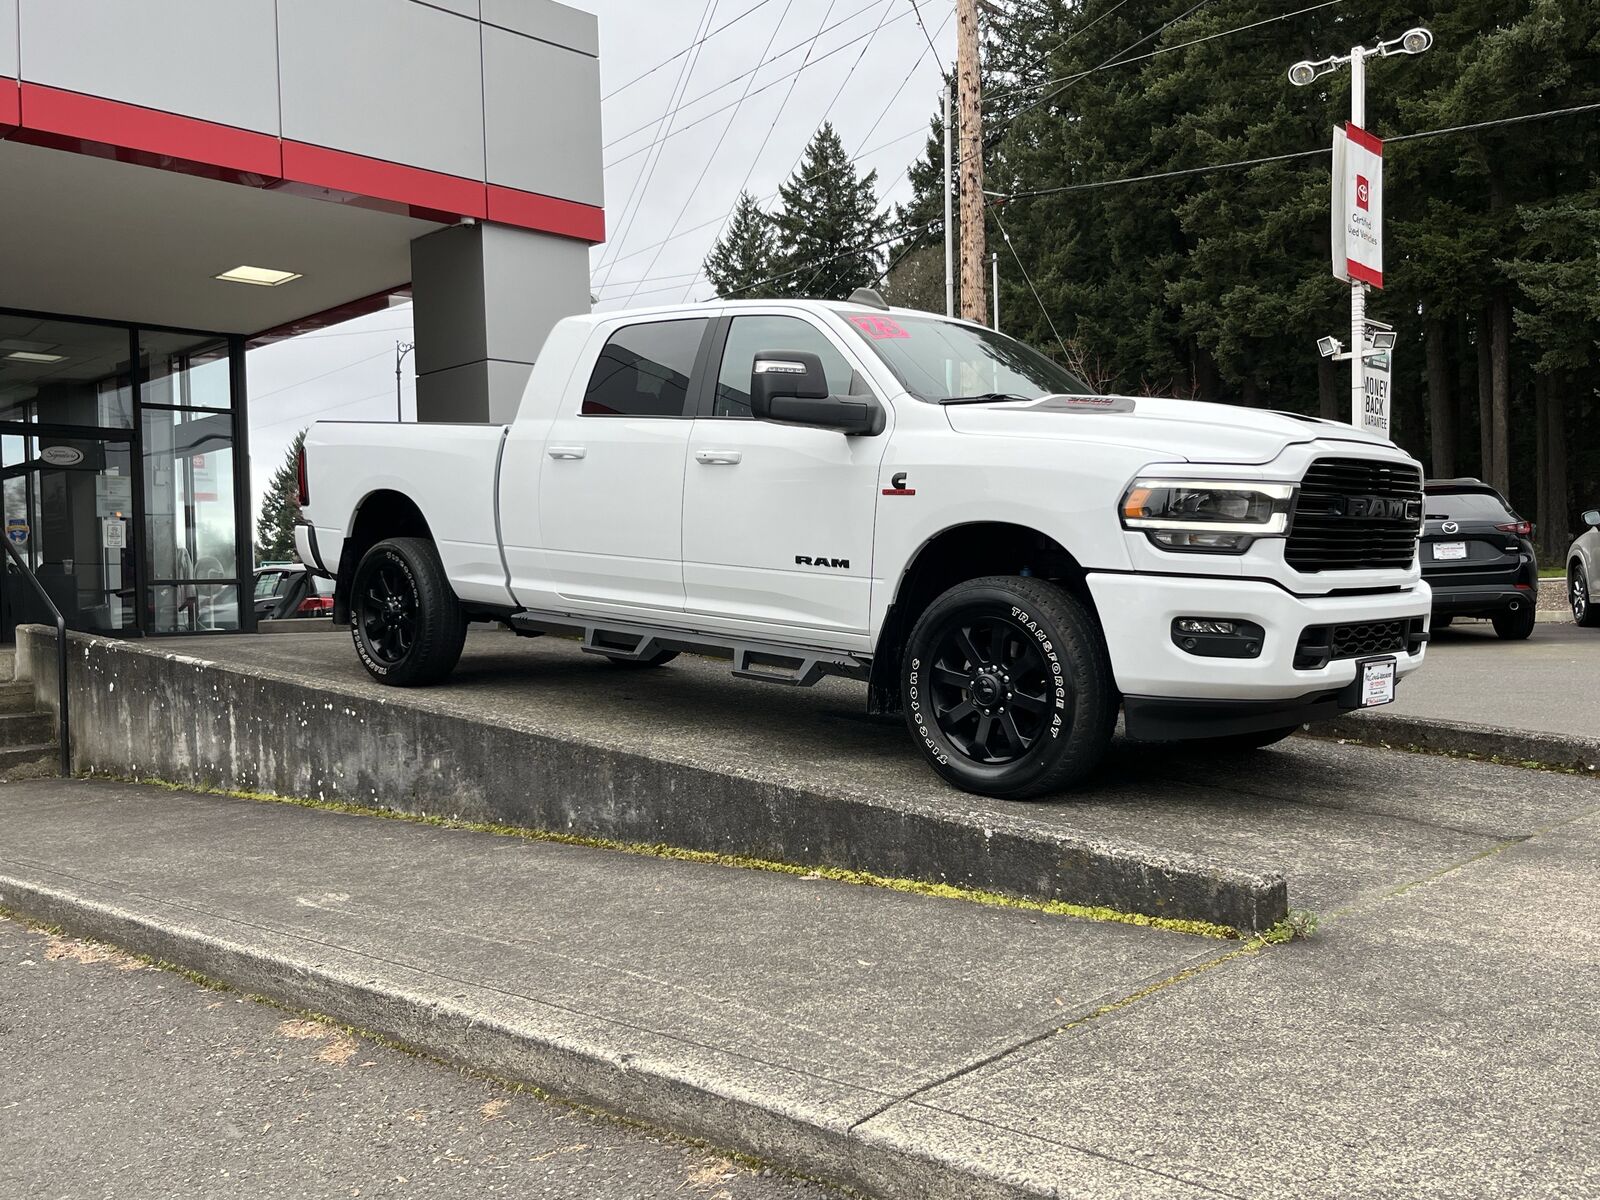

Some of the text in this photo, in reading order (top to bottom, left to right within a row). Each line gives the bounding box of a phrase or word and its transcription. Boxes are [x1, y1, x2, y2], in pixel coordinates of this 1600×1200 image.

[1348, 224, 1378, 246] Used Vehicles
[1364, 376, 1388, 399] MONEY
[1365, 395, 1384, 416] BACK
[1364, 415, 1388, 430] UARANTEE
[1347, 498, 1404, 518] RAM
[795, 556, 850, 569] RAM
[1011, 606, 1066, 739] TRANSFORCE AT
[909, 658, 949, 765] Firestone
